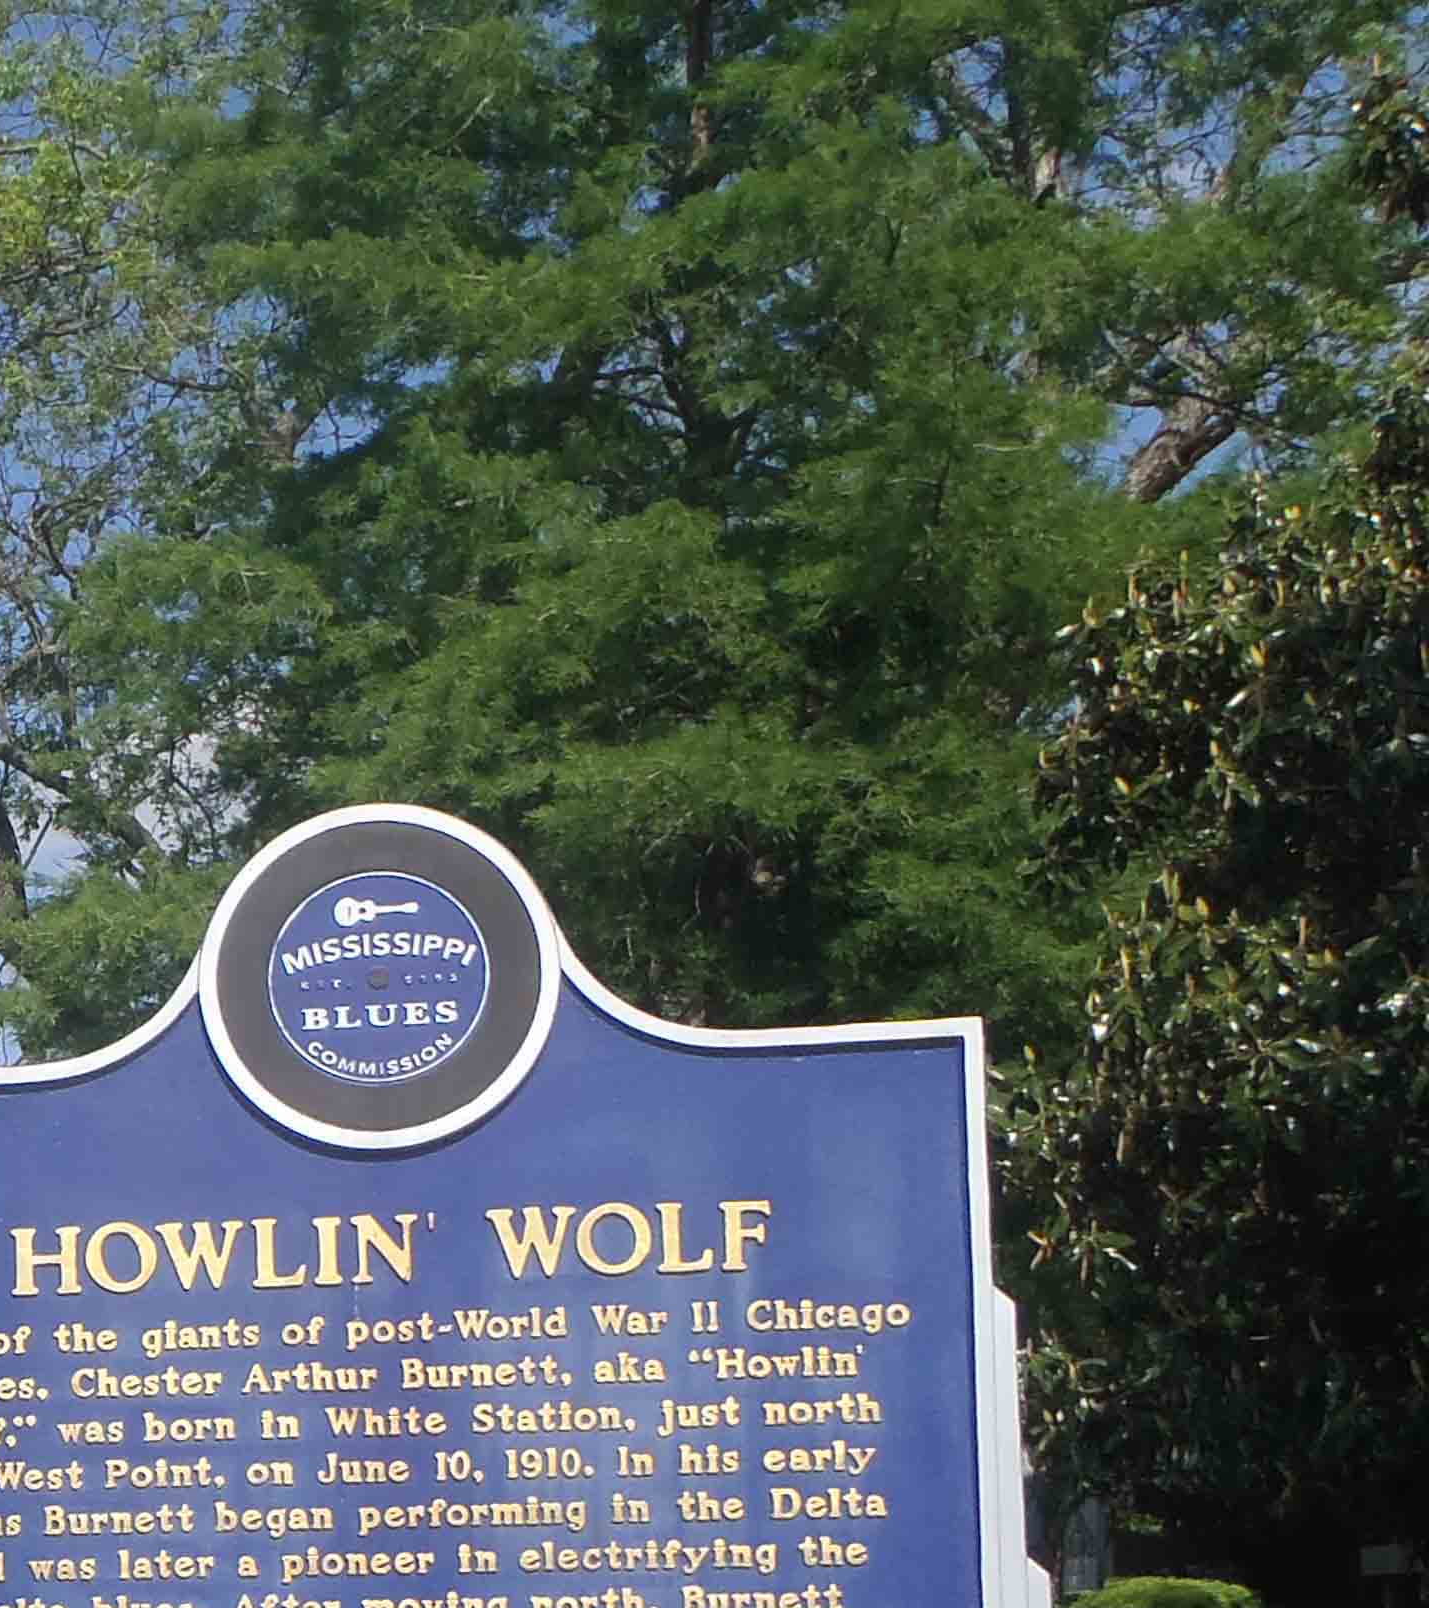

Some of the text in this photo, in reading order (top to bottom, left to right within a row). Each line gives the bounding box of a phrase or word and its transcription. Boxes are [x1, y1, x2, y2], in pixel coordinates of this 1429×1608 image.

[282, 932, 478, 975] MISSISSIPPI
[301, 1001, 459, 1031] BLUES
[307, 1033, 453, 1076] COMMISSION
[12, 1200, 775, 1298] HOWLIN' WOLF
[55, 1322, 120, 1356] the
[142, 1318, 263, 1361] giants
[283, 1316, 327, 1347] of
[348, 1306, 572, 1353] post-World
[593, 1305, 672, 1340] War
[693, 1300, 723, 1335] II
[748, 1299, 915, 1336] Chicago
[72, 1366, 227, 1400] Chester
[244, 1361, 382, 1395] Arthur
[404, 1354, 576, 1393] Burnett,
[596, 1350, 670, 1386] aka
[60, 1421, 127, 1445] was
[145, 1409, 240, 1445] born
[262, 1408, 304, 1442] in
[328, 1407, 450, 1441] White
[472, 1399, 641, 1438] Station,
[660, 1396, 743, 1440] just
[764, 1392, 886, 1427] north
[107, 1457, 230, 1490] Point,
[246, 1461, 297, 1488] on
[319, 1455, 414, 1486] June
[437, 1450, 487, 1485] 10,
[508, 1447, 598, 1483] 1910.
[619, 1446, 659, 1481] In
[679, 1443, 743, 1477] his
[765, 1440, 878, 1477] early
[46, 1504, 197, 1538] Burnett
[215, 1500, 337, 1539] began
[360, 1497, 590, 1538] performing
[613, 1492, 653, 1524] in
[678, 1490, 748, 1524] the
[772, 1487, 890, 1522] Delta
[30, 1557, 100, 1585] was
[120, 1551, 217, 1584] later
[239, 1556, 263, 1580] a
[283, 1546, 438, 1586] pioneer
[460, 1543, 502, 1577] in
[521, 1537, 782, 1577] electrifying
[800, 1536, 871, 1570] the
